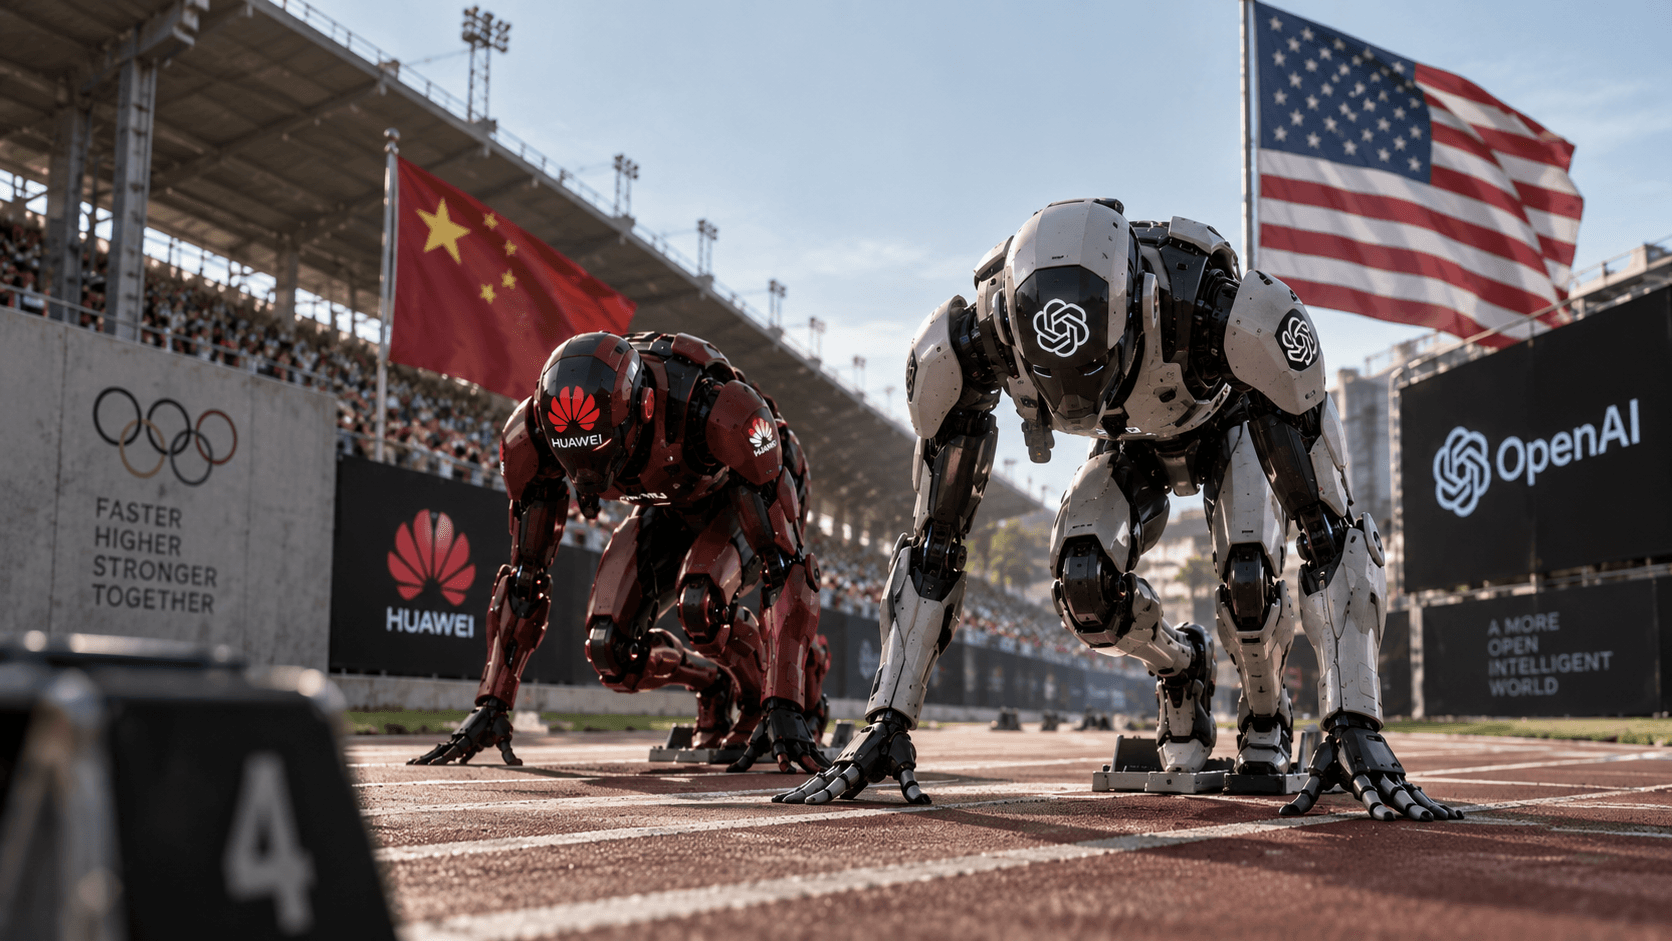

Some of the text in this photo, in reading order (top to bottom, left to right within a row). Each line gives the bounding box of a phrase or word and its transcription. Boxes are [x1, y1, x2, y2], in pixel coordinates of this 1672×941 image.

[551, 434, 603, 449] HUAWEI
[1496, 398, 1640, 486] OpenAI
[96, 497, 182, 529] FASTER
[95, 526, 181, 557] HIGHER
[92, 557, 217, 588] STRONGER
[92, 583, 215, 614] TOGETHER
[386, 606, 475, 639] HUAWEI
[1487, 612, 1560, 636] A MORE
[1487, 635, 1539, 657] OPEN
[1488, 651, 1614, 677] INTELLIGENT
[1489, 677, 1559, 697] WORLD
[223, 751, 315, 935] 4
